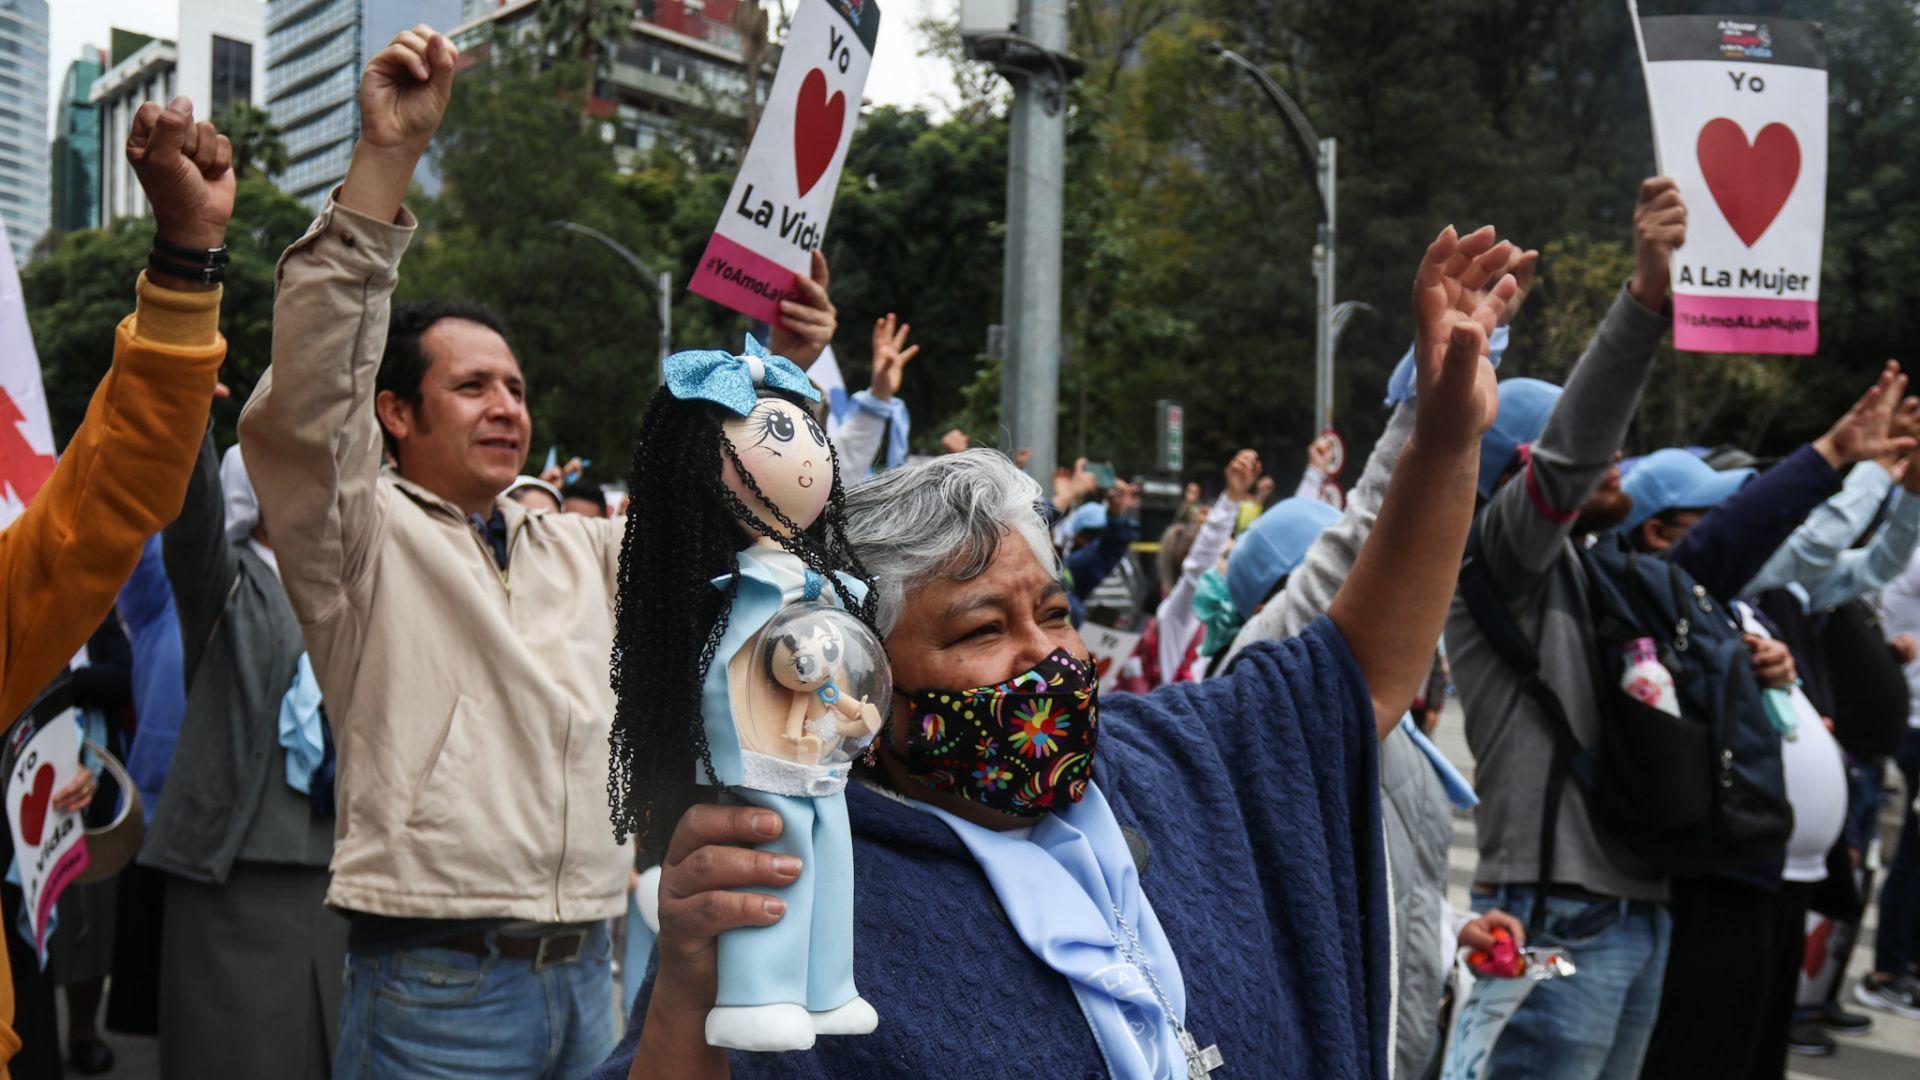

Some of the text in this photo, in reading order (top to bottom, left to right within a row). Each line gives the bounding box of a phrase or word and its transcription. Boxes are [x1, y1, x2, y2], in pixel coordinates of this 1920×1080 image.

[828, 25, 850, 74] Yo
[1728, 71, 1765, 93] Yo
[736, 183, 774, 229] La
[1680, 265, 1809, 295] A La Mujer
[17, 752, 37, 783] Yo
